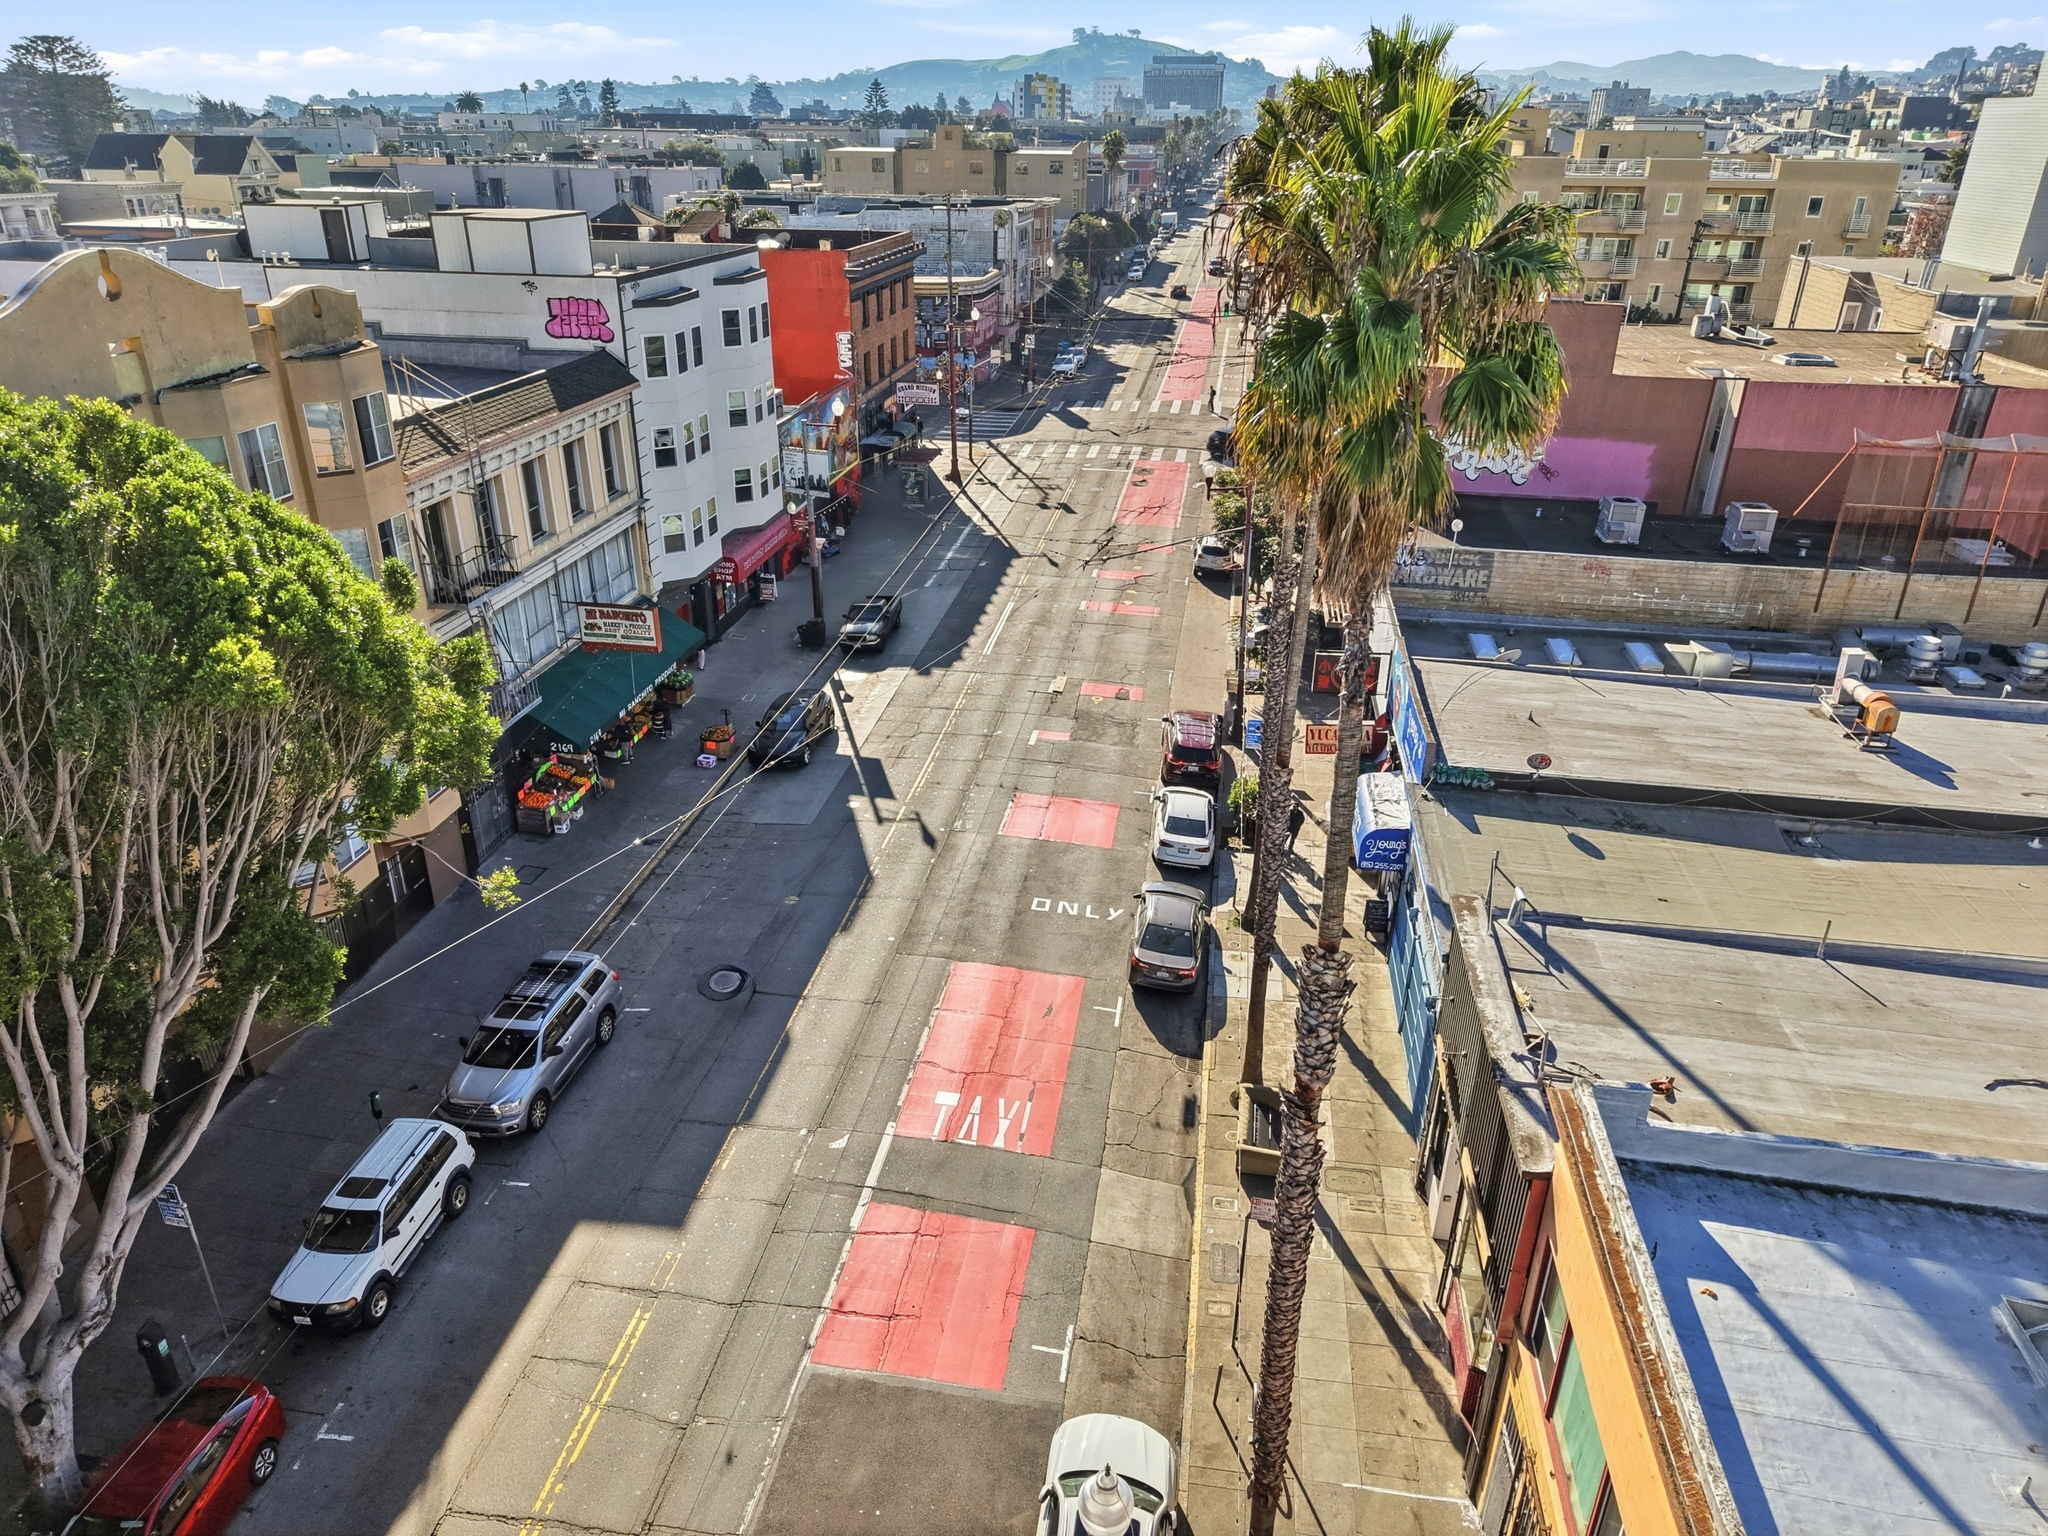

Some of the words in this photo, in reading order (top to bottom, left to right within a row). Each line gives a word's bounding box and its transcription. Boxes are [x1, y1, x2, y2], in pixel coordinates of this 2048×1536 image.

[598, 609, 647, 624] RANCHITO
[603, 621, 624, 629] MARKET
[629, 623, 652, 631] PRODUCE
[627, 683, 654, 711] RANCHITO
[654, 661, 678, 687] PRODUCE
[550, 742, 574, 753] 2169
[1365, 838, 1407, 860] Young's
[1030, 897, 1125, 921] ONLY
[932, 1091, 1035, 1154] TAXI
